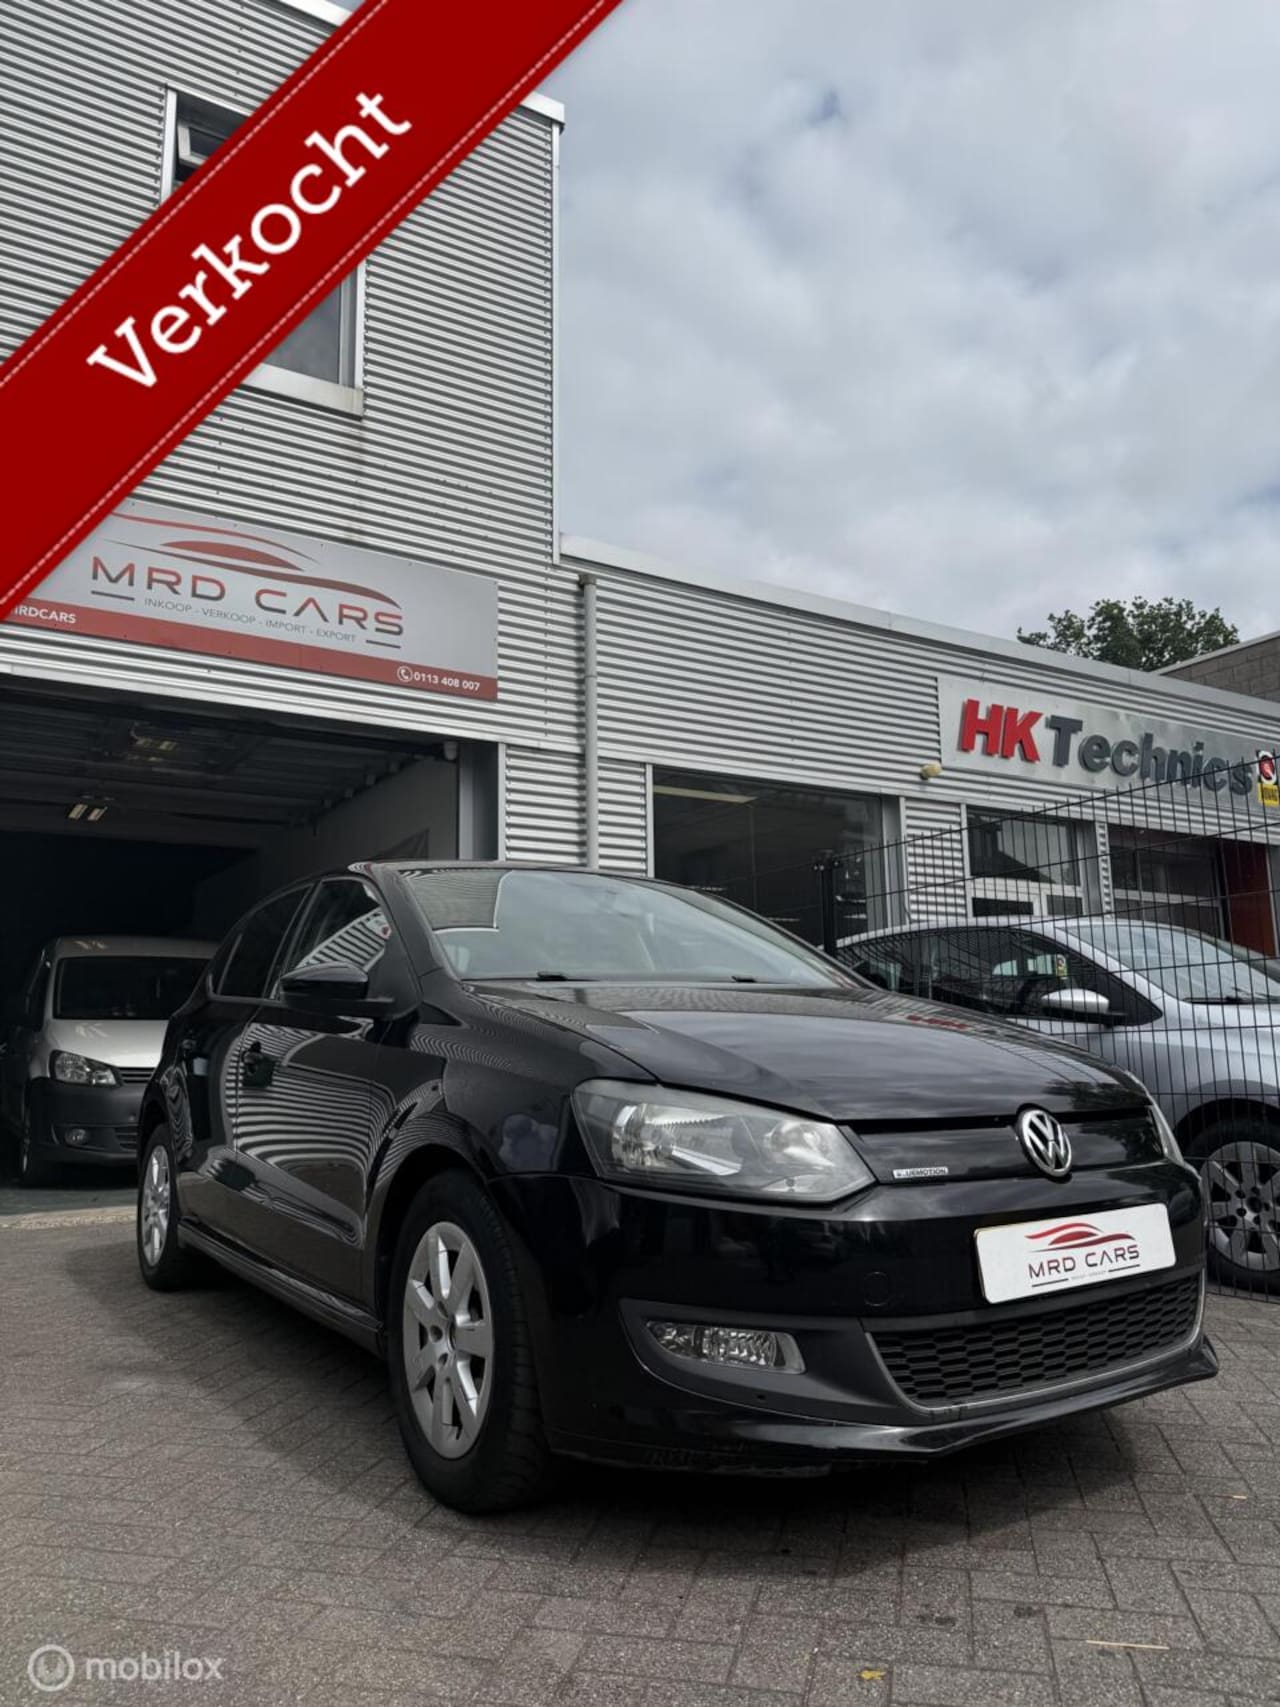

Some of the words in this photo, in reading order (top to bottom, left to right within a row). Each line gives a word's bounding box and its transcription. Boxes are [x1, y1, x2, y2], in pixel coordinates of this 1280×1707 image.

[91, 556, 226, 601] MRD
[255, 588, 404, 636] CARS
[144, 598, 193, 613] INKOOP
[201, 607, 257, 624] VERKOOP
[265, 619, 307, 634] IMPORT
[316, 629, 356, 643] EXPORT
[413, 671, 439, 684] 0113
[441, 677, 460, 688] 408
[462, 680, 480, 691] 007
[1028, 1256, 1076, 1279] MRD
[1085, 1244, 1140, 1267] CARS
